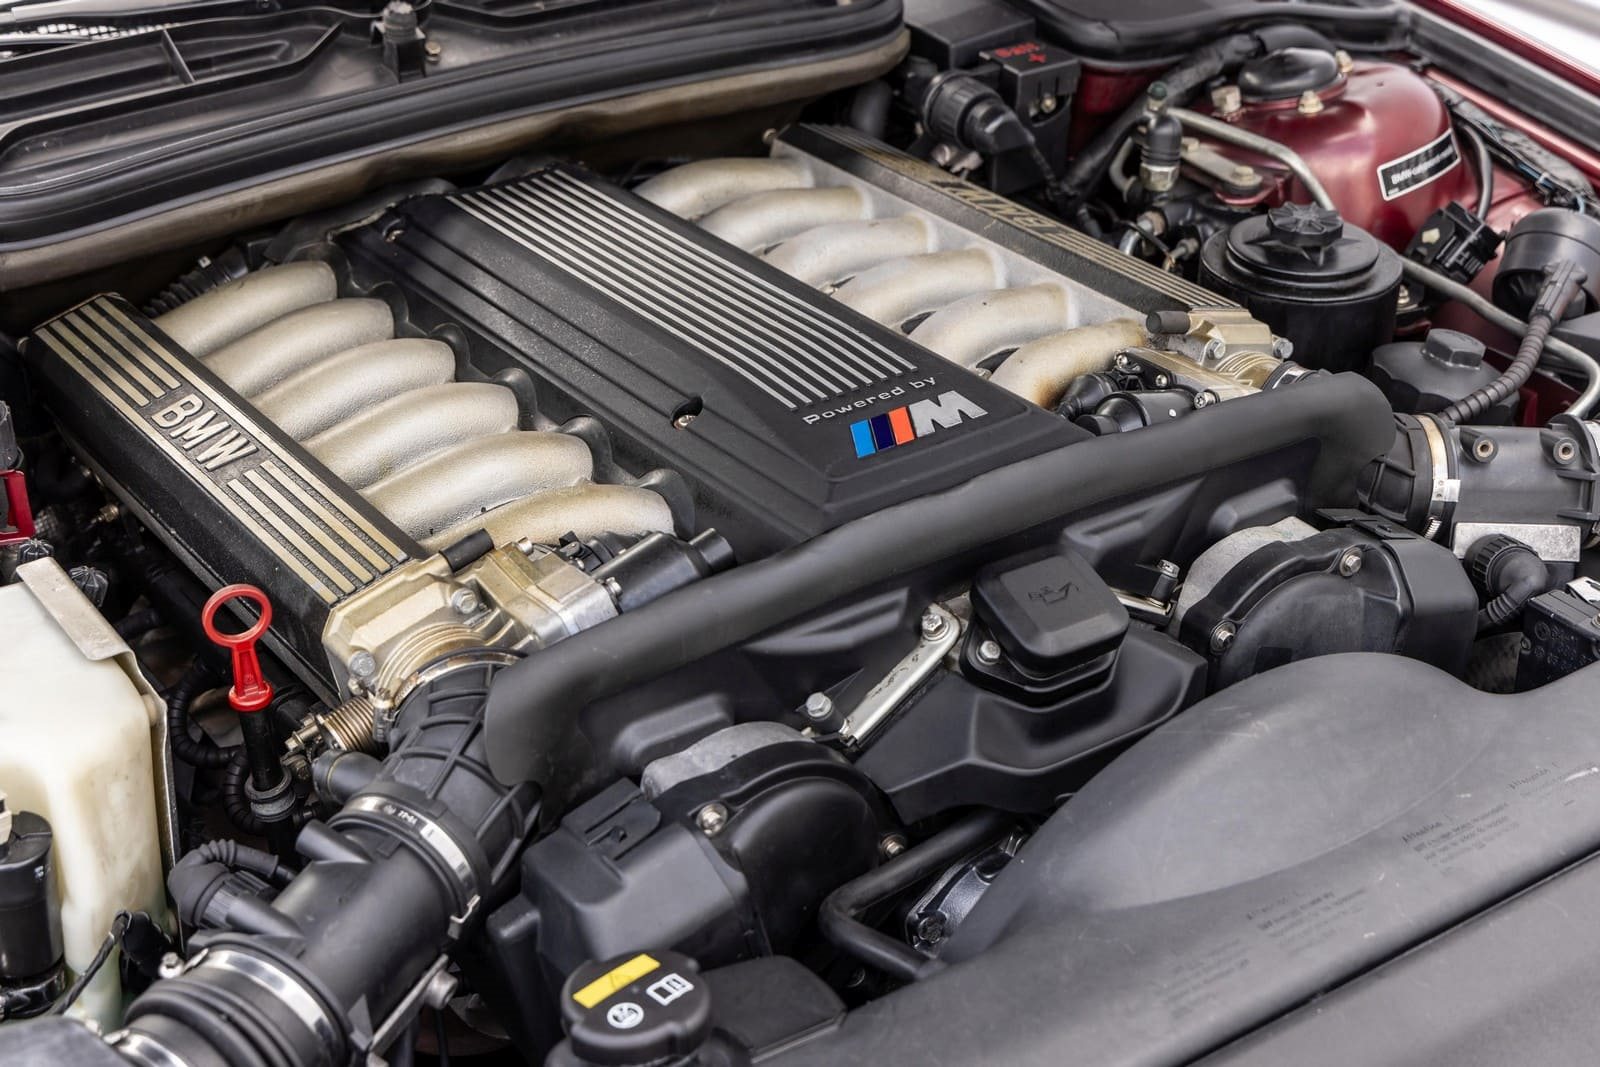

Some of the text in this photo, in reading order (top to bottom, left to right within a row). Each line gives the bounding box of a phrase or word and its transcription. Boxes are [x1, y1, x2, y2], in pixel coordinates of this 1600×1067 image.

[802, 376, 936, 425] Powered by
[908, 390, 989, 438] M
[151, 393, 260, 472] BMW
